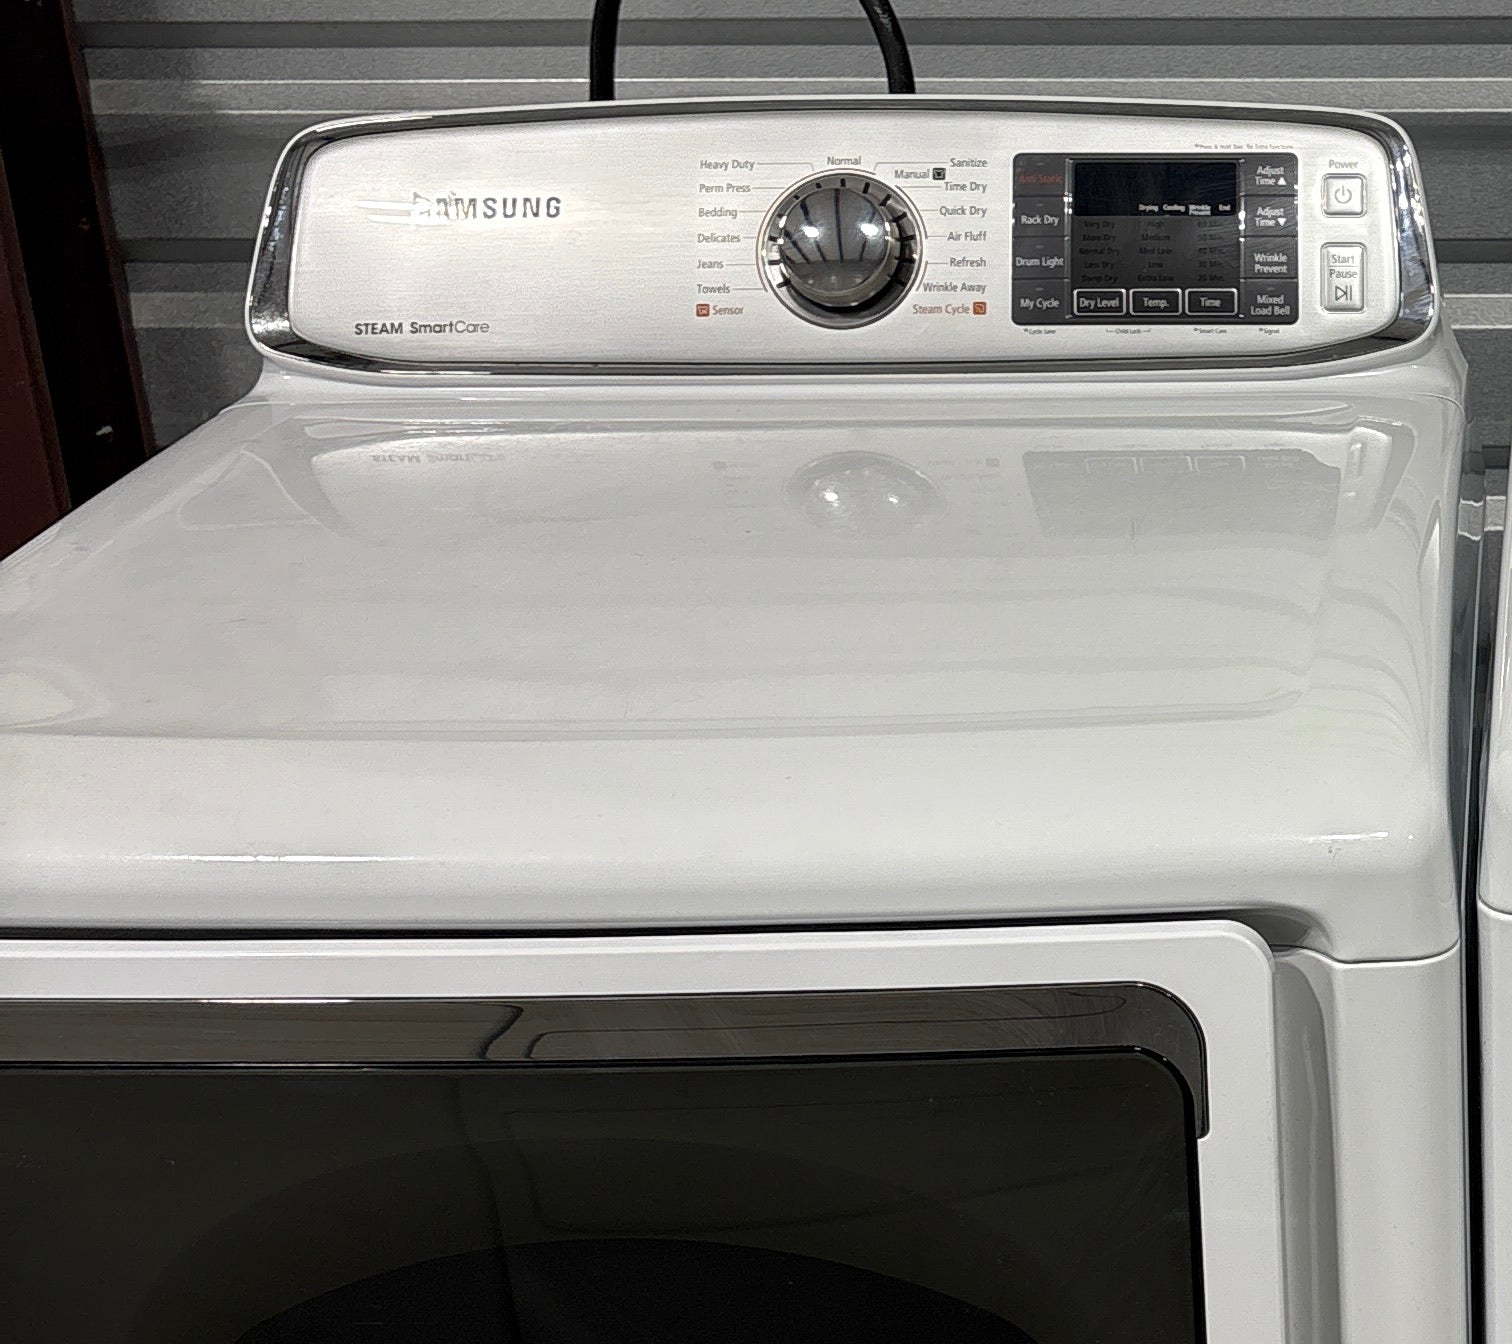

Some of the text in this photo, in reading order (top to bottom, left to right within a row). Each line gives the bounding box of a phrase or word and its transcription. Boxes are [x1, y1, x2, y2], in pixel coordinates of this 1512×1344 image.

[700, 159, 756, 172] Heavy Duty
[826, 155, 862, 166] Normal
[950, 157, 988, 168] Sanitize
[1328, 159, 1359, 169] Power
[894, 168, 930, 179] Manual
[1256, 165, 1285, 177] Adjust
[1254, 176, 1277, 186] Time
[699, 183, 751, 193] Perm Press
[944, 182, 988, 194] Time Dry
[698, 207, 738, 219] Bedding
[939, 206, 988, 218] Quick Dry
[1256, 206, 1285, 218] Adjust
[1020, 214, 1059, 227] Rack Dry
[1254, 217, 1277, 227] Time
[697, 232, 741, 244] Delicates
[947, 230, 987, 242] Air Fluff
[949, 256, 987, 268] Refresh
[1015, 256, 1064, 269] Drum Light
[1253, 252, 1288, 263] Wrinkle
[1331, 254, 1355, 264] Start
[696, 259, 724, 269] Jeans
[1254, 263, 1288, 274] Prevent
[1329, 268, 1358, 278] Pause
[696, 283, 731, 294] Towels
[923, 282, 987, 295] Wrinkle Away
[1020, 297, 1060, 311] My Cycle
[1079, 297, 1119, 309] Dry Level
[1143, 298, 1169, 310] Temp.
[1200, 297, 1221, 308] Time
[1256, 294, 1285, 304] Mixed
[712, 305, 744, 316] Sensor
[912, 303, 970, 316] Steam Cycle
[1250, 305, 1291, 315] Load Bell
[354, 320, 490, 336] STEAM SmartCare
